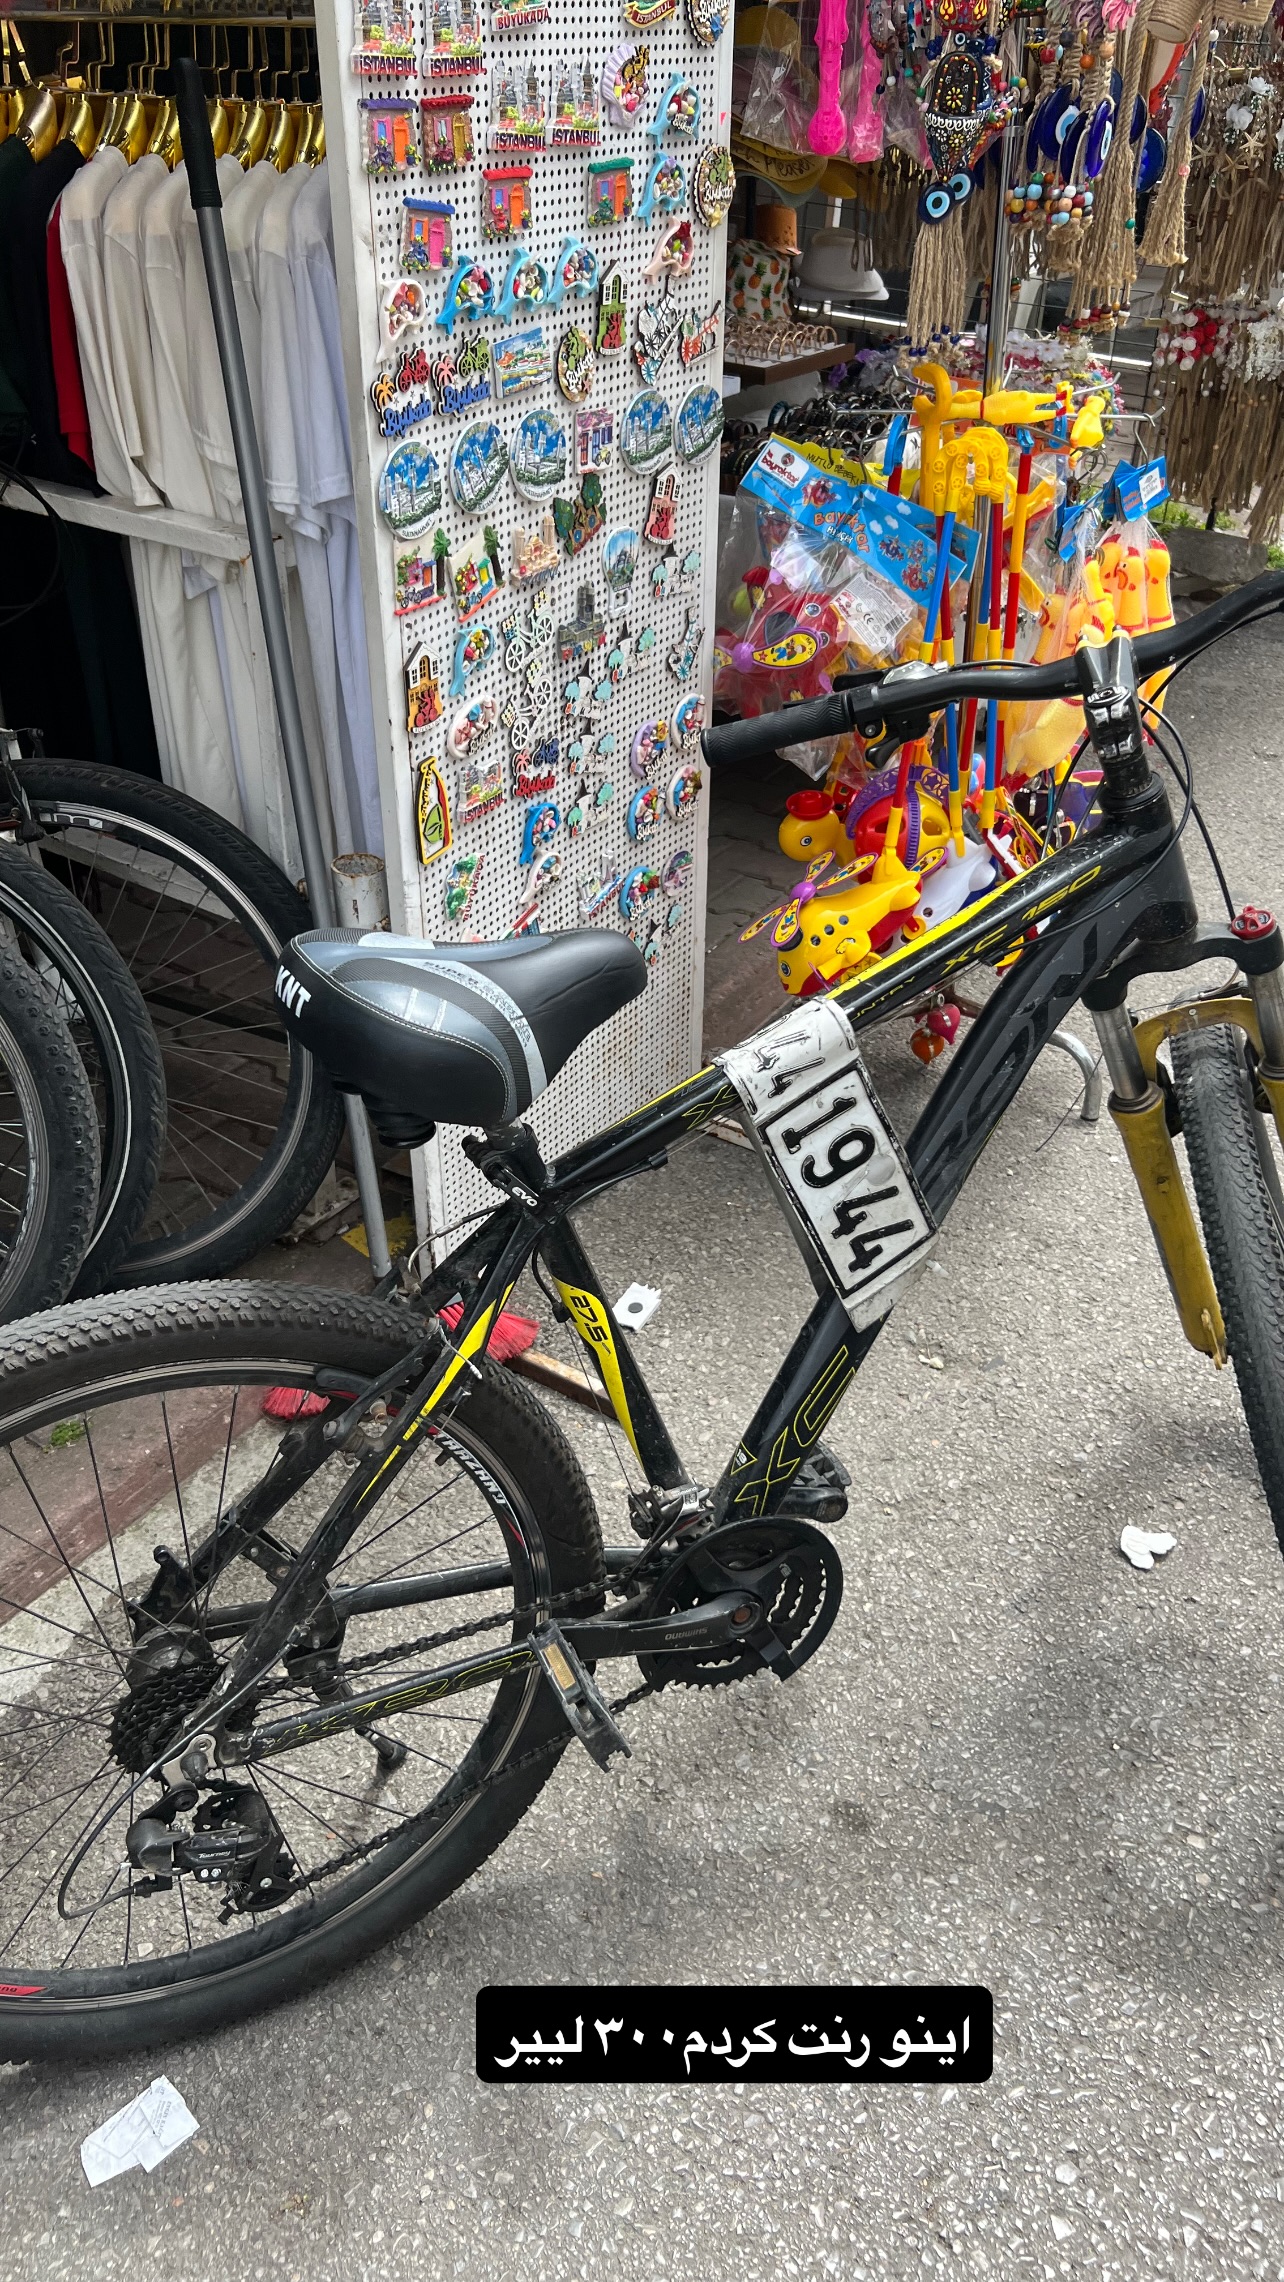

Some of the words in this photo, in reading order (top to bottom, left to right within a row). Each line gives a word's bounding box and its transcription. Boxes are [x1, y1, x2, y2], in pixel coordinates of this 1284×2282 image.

[940, 924, 1008, 976] XC
[274, 964, 312, 1019] KNT
[512, 1187, 538, 1207] EVO
[781, 1096, 915, 1273] 1944
